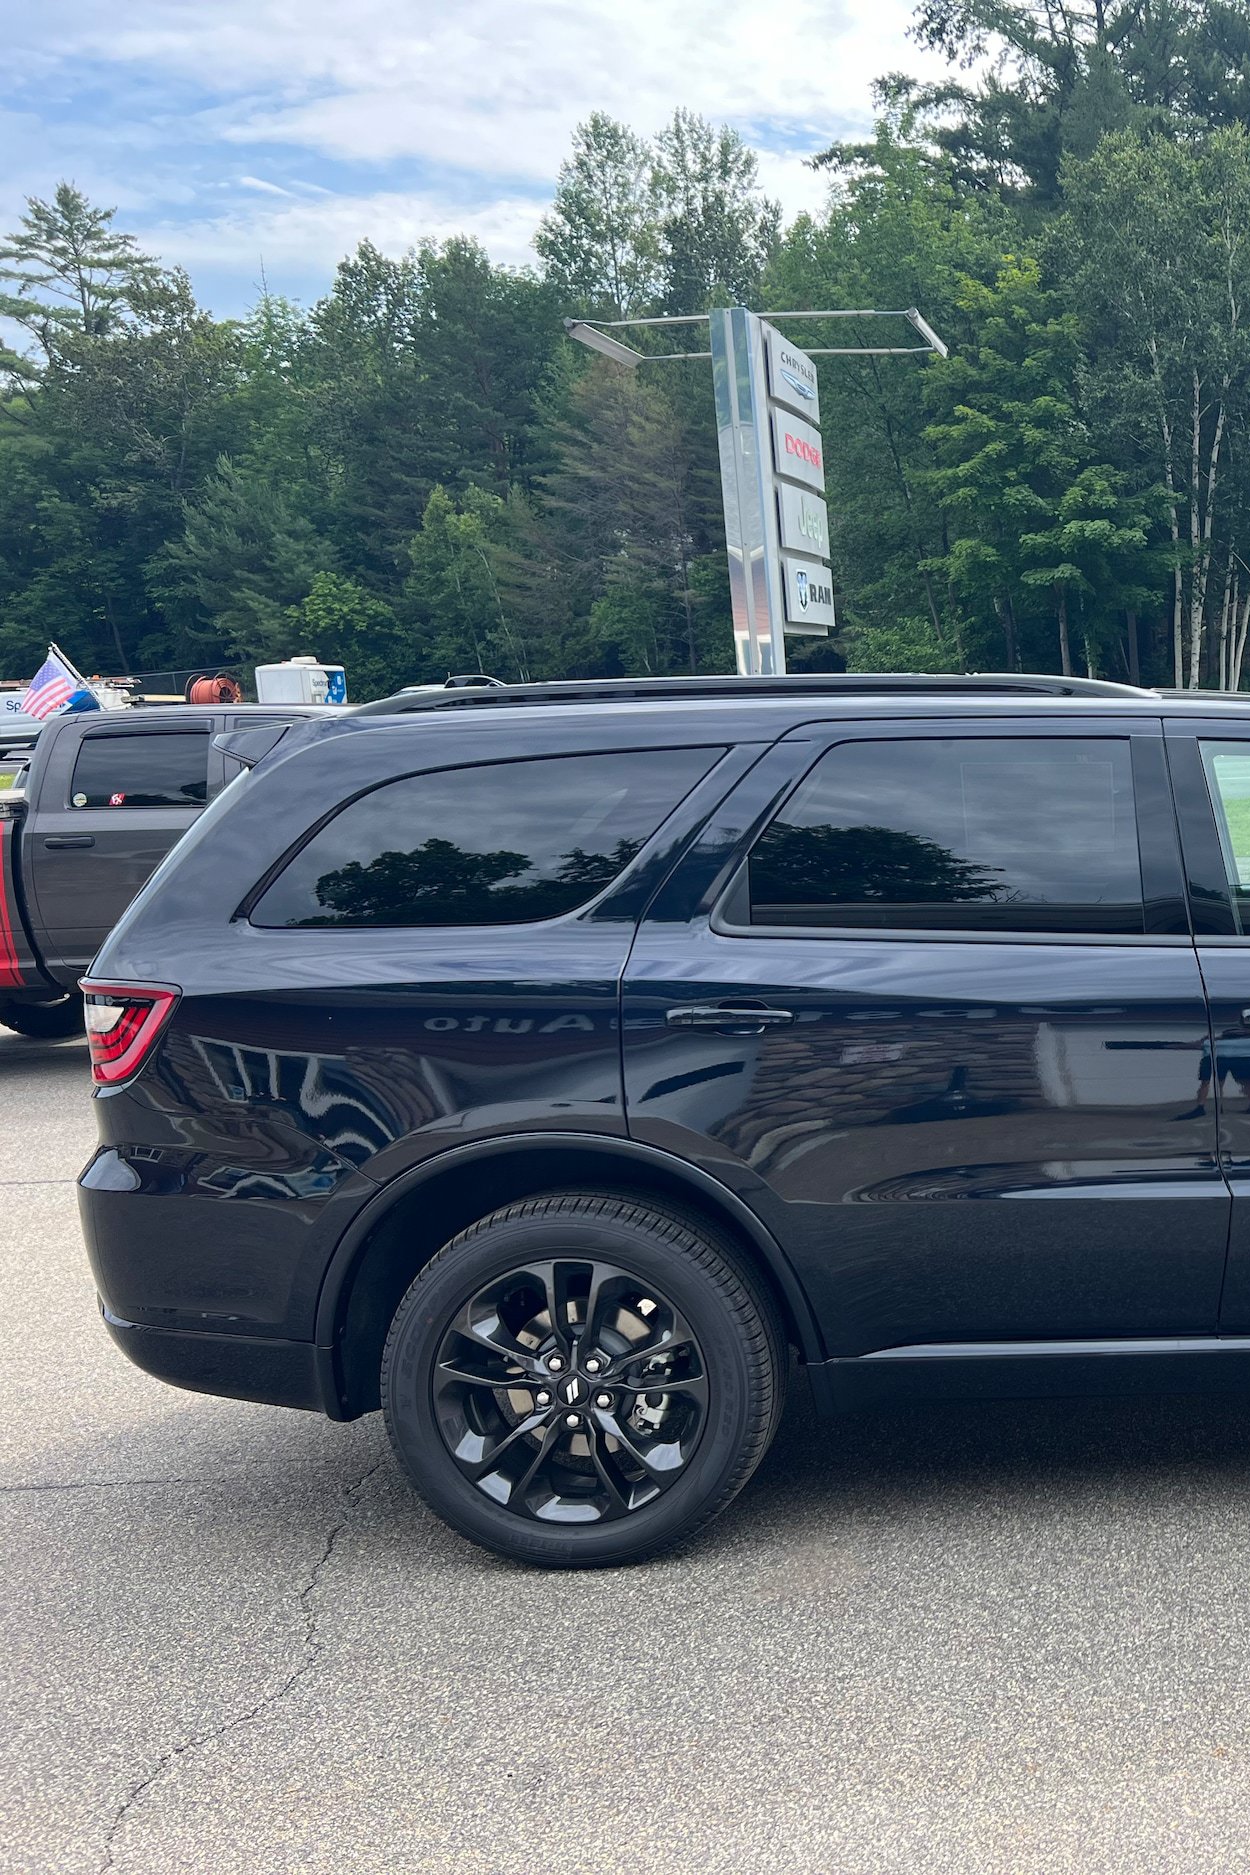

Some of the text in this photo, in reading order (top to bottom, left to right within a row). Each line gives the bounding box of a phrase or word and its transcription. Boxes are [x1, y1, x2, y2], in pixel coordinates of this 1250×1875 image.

[780, 351, 815, 384] CHRYSLER
[784, 432, 821, 470] DODGE
[797, 495, 823, 549] Jeep
[809, 583, 832, 606] RAM
